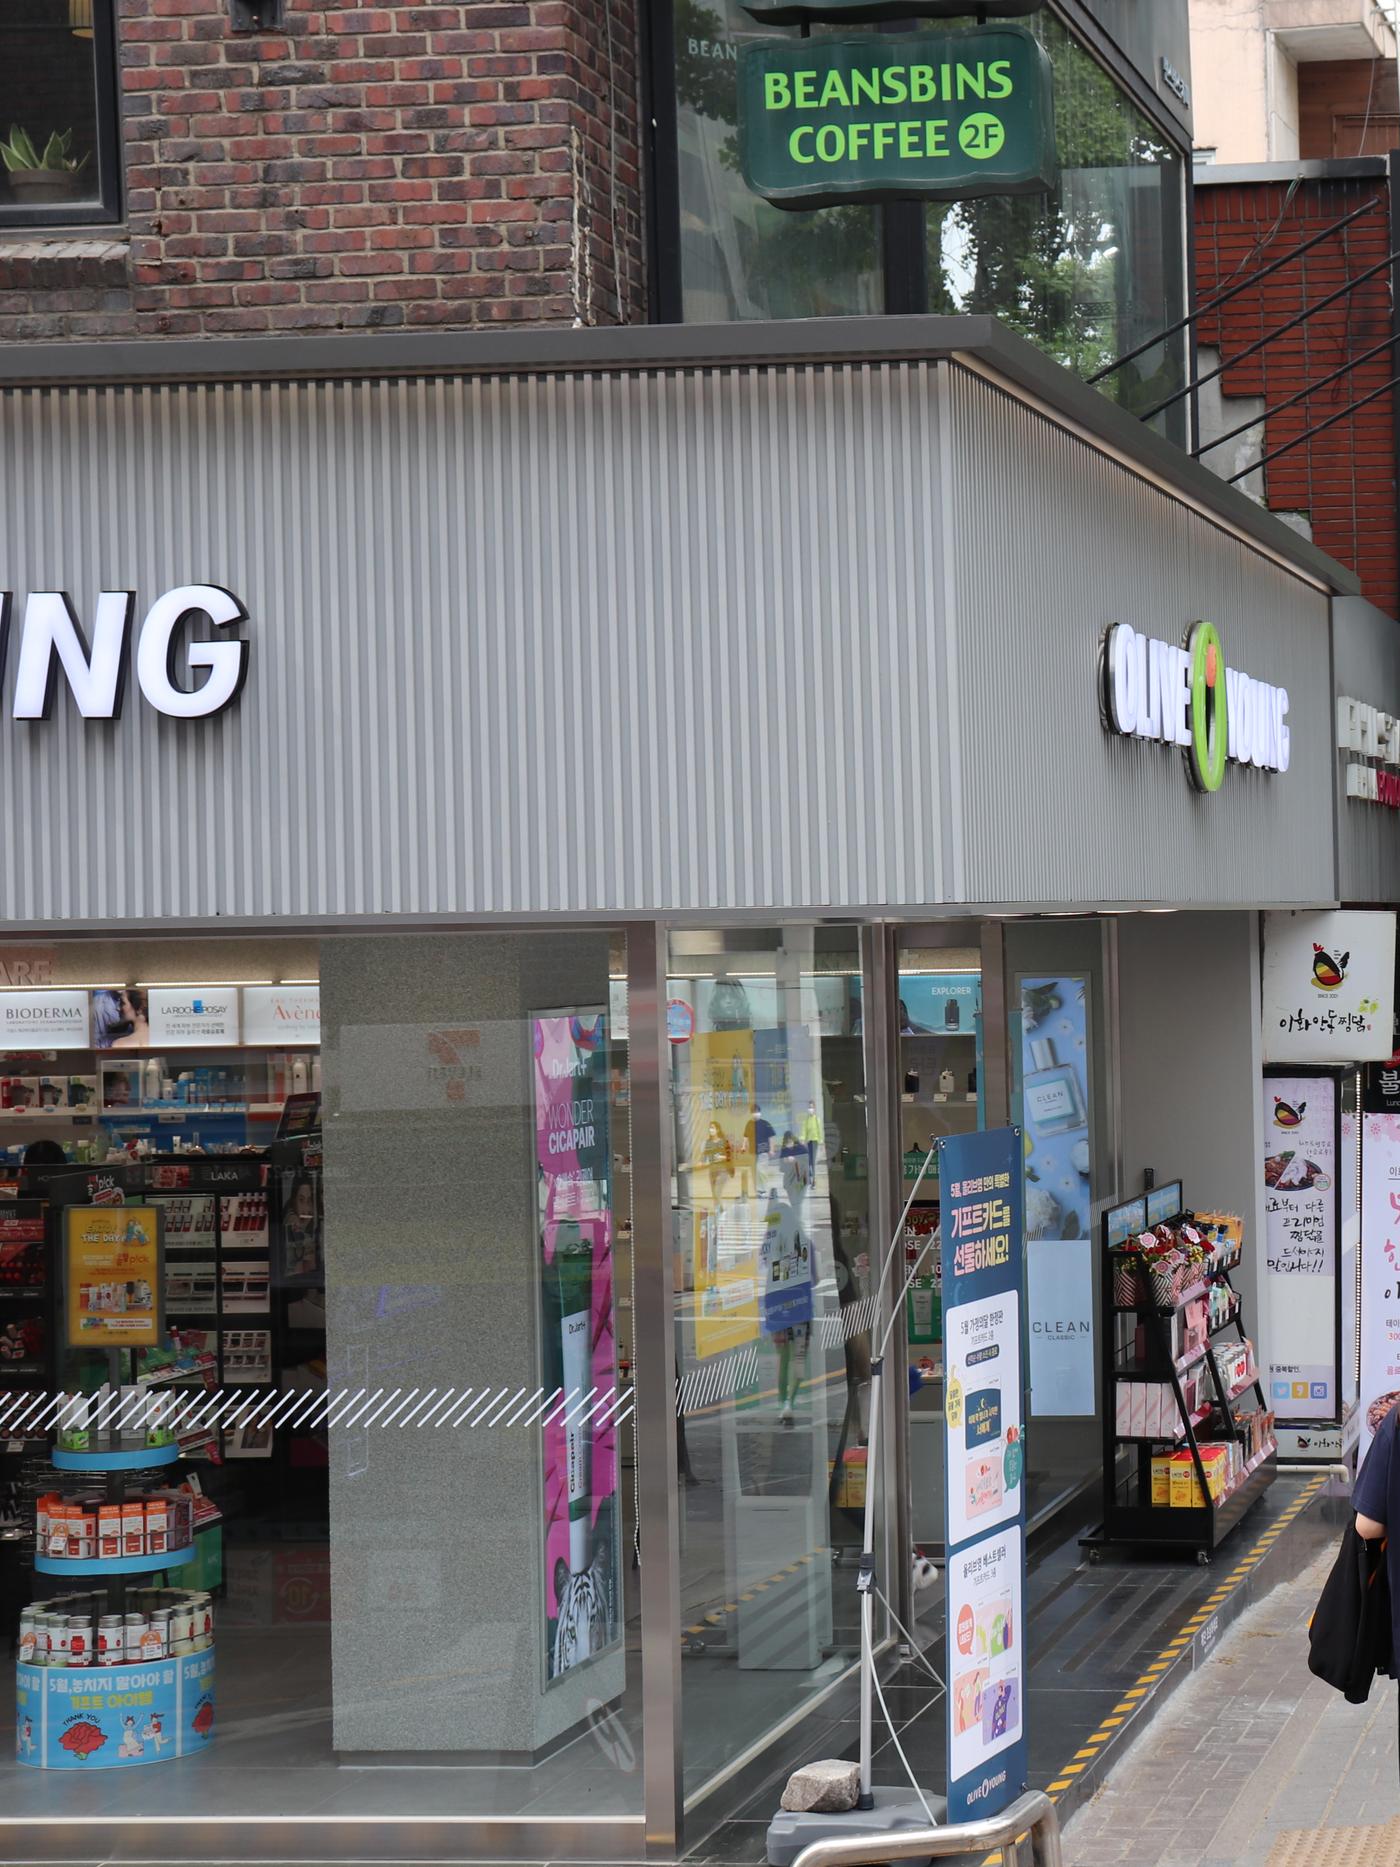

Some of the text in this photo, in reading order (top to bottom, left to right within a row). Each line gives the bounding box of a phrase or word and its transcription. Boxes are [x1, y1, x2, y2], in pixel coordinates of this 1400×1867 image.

[764, 59, 1013, 110] BEANSBINS
[788, 119, 1000, 164] COFFEE 2F
[0, 583, 250, 721] NG
[1108, 622, 1192, 748] OLIVE
[1225, 666, 1290, 774] YOUNG
[931, 986, 972, 996] EXPLORER
[6, 1007, 82, 1019] BIODERMA
[551, 1058, 588, 1077] Dr.Jart+
[550, 1099, 594, 1129] WONDER
[548, 1126, 596, 1154] CICAPAIR
[211, 1171, 238, 1182] LAKA
[1305, 1198, 1325, 1213] 다른
[951, 1199, 1011, 1239] 기프트카드를
[1282, 1215, 1325, 1228] 프리미엄
[1289, 1229, 1325, 1244] 찜닭을
[953, 1234, 1010, 1277] 선물하세요!
[1032, 1320, 1090, 1333] CLEAN
[962, 1557, 982, 1579] 올리브영
[50, 1669, 175, 1694] 5월,놓치지 말아야 할
[70, 1690, 153, 1709] 기프트 아이템
[63, 1711, 101, 1726] THANK YOU
[987, 1769, 1007, 1790] YOUNG
